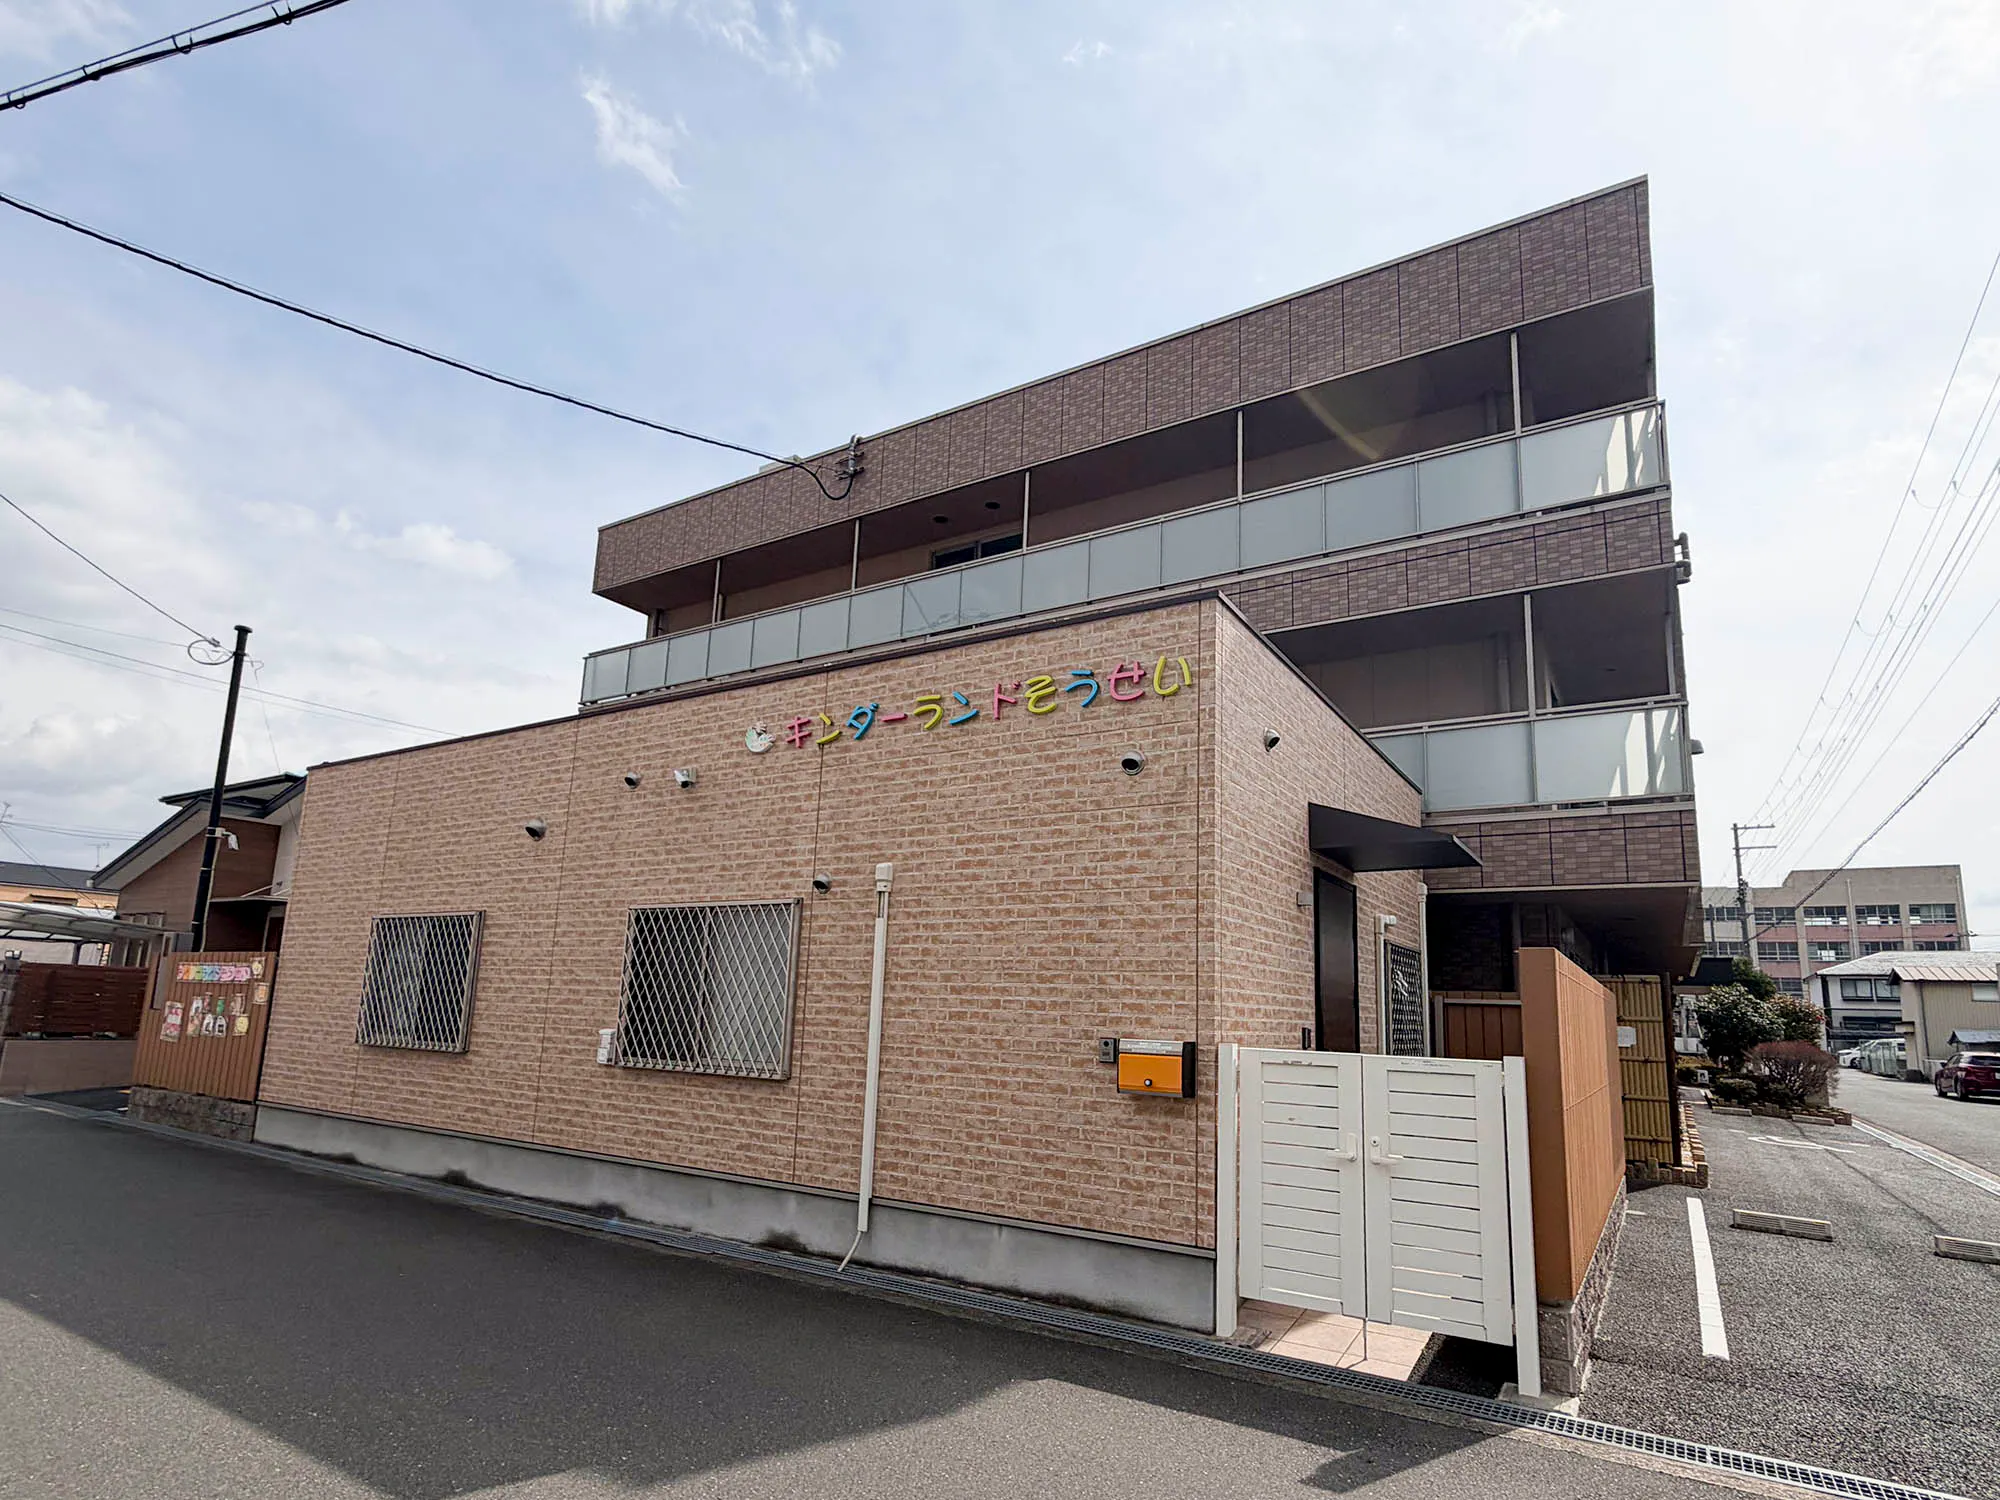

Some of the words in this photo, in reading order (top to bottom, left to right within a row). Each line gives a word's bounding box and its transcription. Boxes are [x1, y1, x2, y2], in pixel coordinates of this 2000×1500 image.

[785, 656, 1193, 748] キンダーランドそうせい
